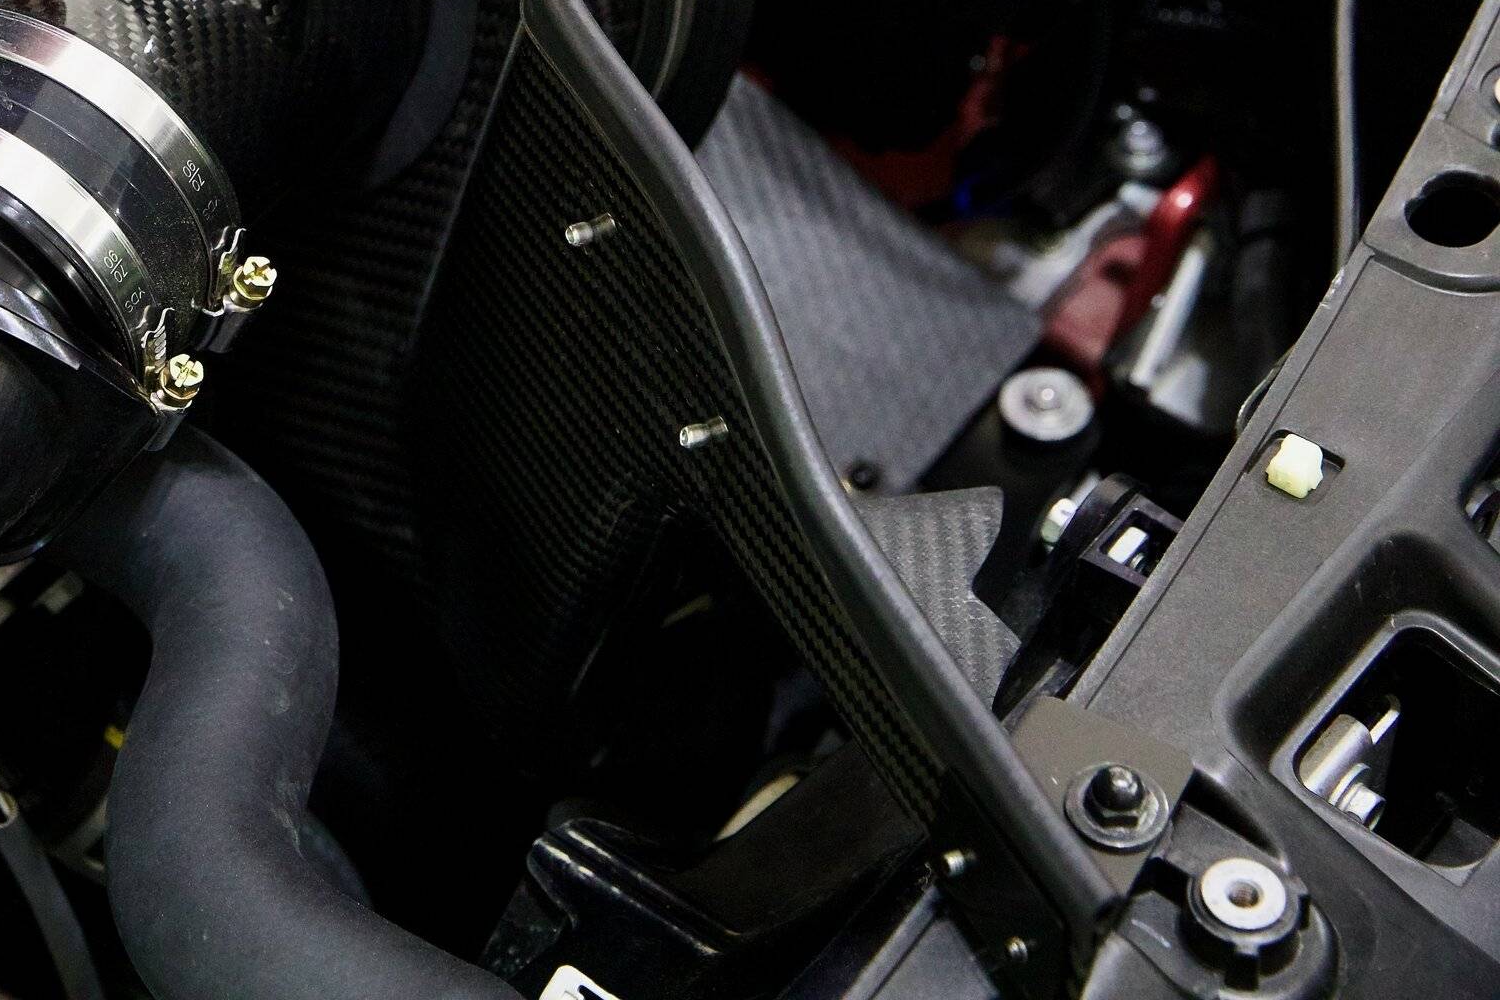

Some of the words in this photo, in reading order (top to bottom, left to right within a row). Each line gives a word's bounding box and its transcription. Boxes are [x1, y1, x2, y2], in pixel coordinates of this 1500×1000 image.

[182, 159, 197, 178] 90
[192, 173, 206, 192] 70
[103, 249, 119, 269] 90
[113, 264, 129, 283] 70
[124, 286, 146, 314] YDS
